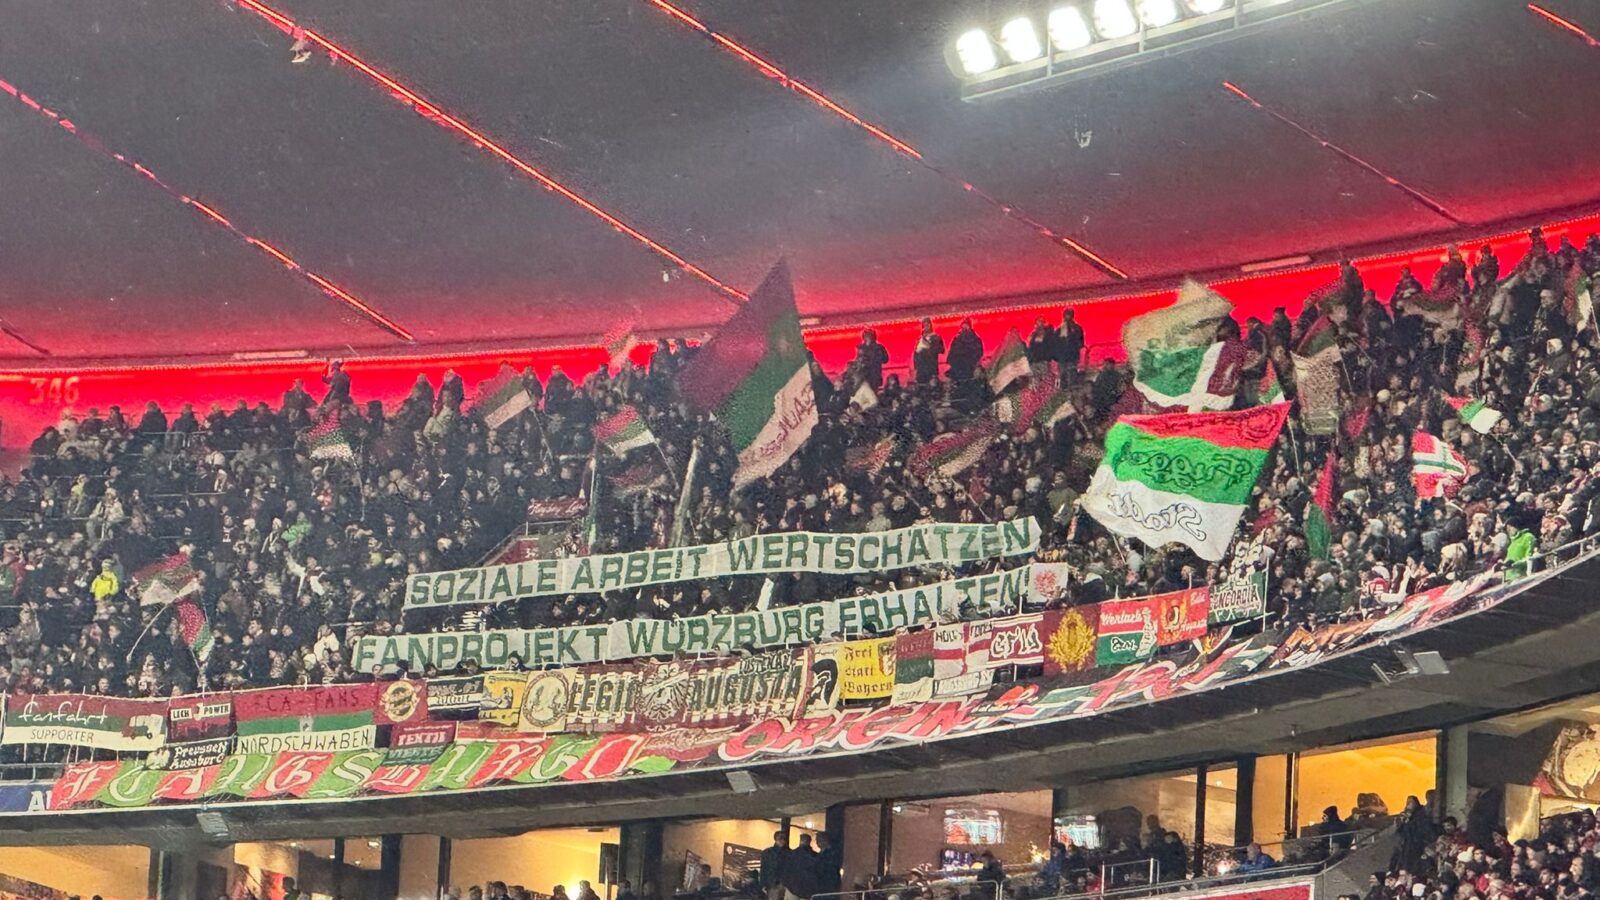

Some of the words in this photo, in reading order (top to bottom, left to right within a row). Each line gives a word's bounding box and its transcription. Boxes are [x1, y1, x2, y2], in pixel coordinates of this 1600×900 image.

[30, 376, 80, 404] 346
[410, 559, 558, 605] SOZIALE
[571, 547, 707, 590] ARBEIT
[728, 517, 1030, 572] WERTSCHÄTZEN
[354, 627, 608, 670] FANPROJEKT
[844, 645, 872, 661] Frei
[314, 688, 360, 709] FANS
[568, 673, 637, 713] LEGIO
[687, 664, 803, 712] AUGUSTA
[203, 705, 229, 715] POWER
[30, 728, 94, 744] SUPPORTER
[240, 728, 369, 754] NORDSCHWABEN
